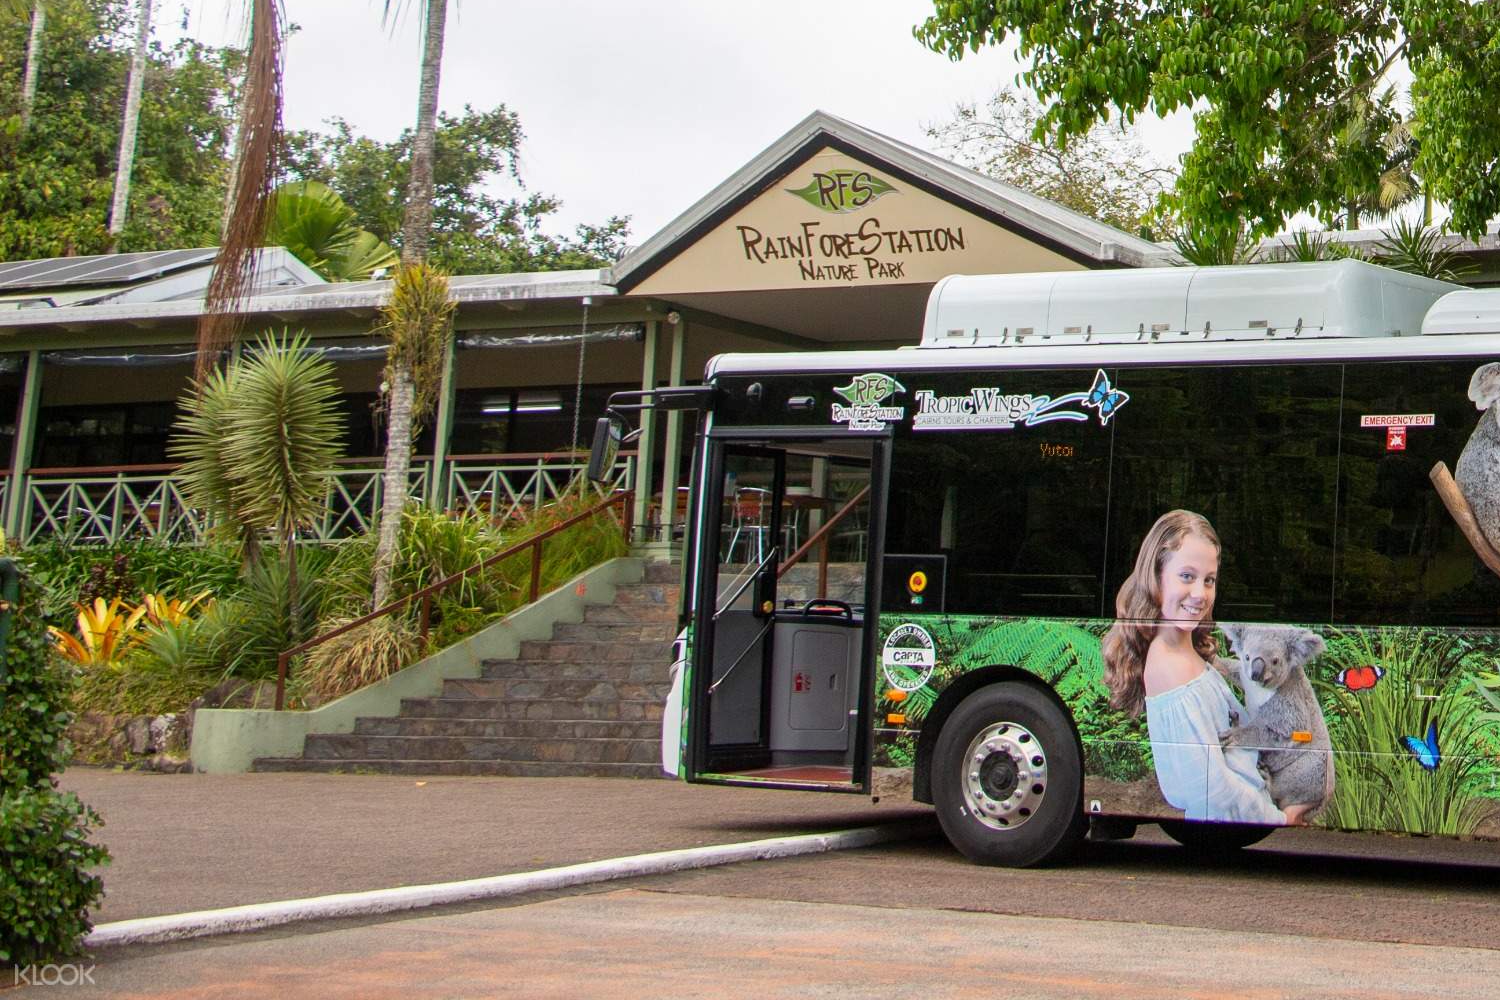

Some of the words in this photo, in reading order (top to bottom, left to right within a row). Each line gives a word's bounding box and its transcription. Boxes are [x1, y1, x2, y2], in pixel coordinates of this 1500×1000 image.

[812, 172, 873, 210] RFS
[736, 217, 965, 264] RAINFORESTATION
[798, 259, 859, 281] NATURE
[864, 257, 905, 280] PARK
[854, 377, 888, 403] RFS
[943, 416, 965, 425] TOURS
[974, 415, 1009, 424] CHARTERS
[1364, 415, 1414, 425] EMERGENCY
[1415, 415, 1433, 424] EXIT
